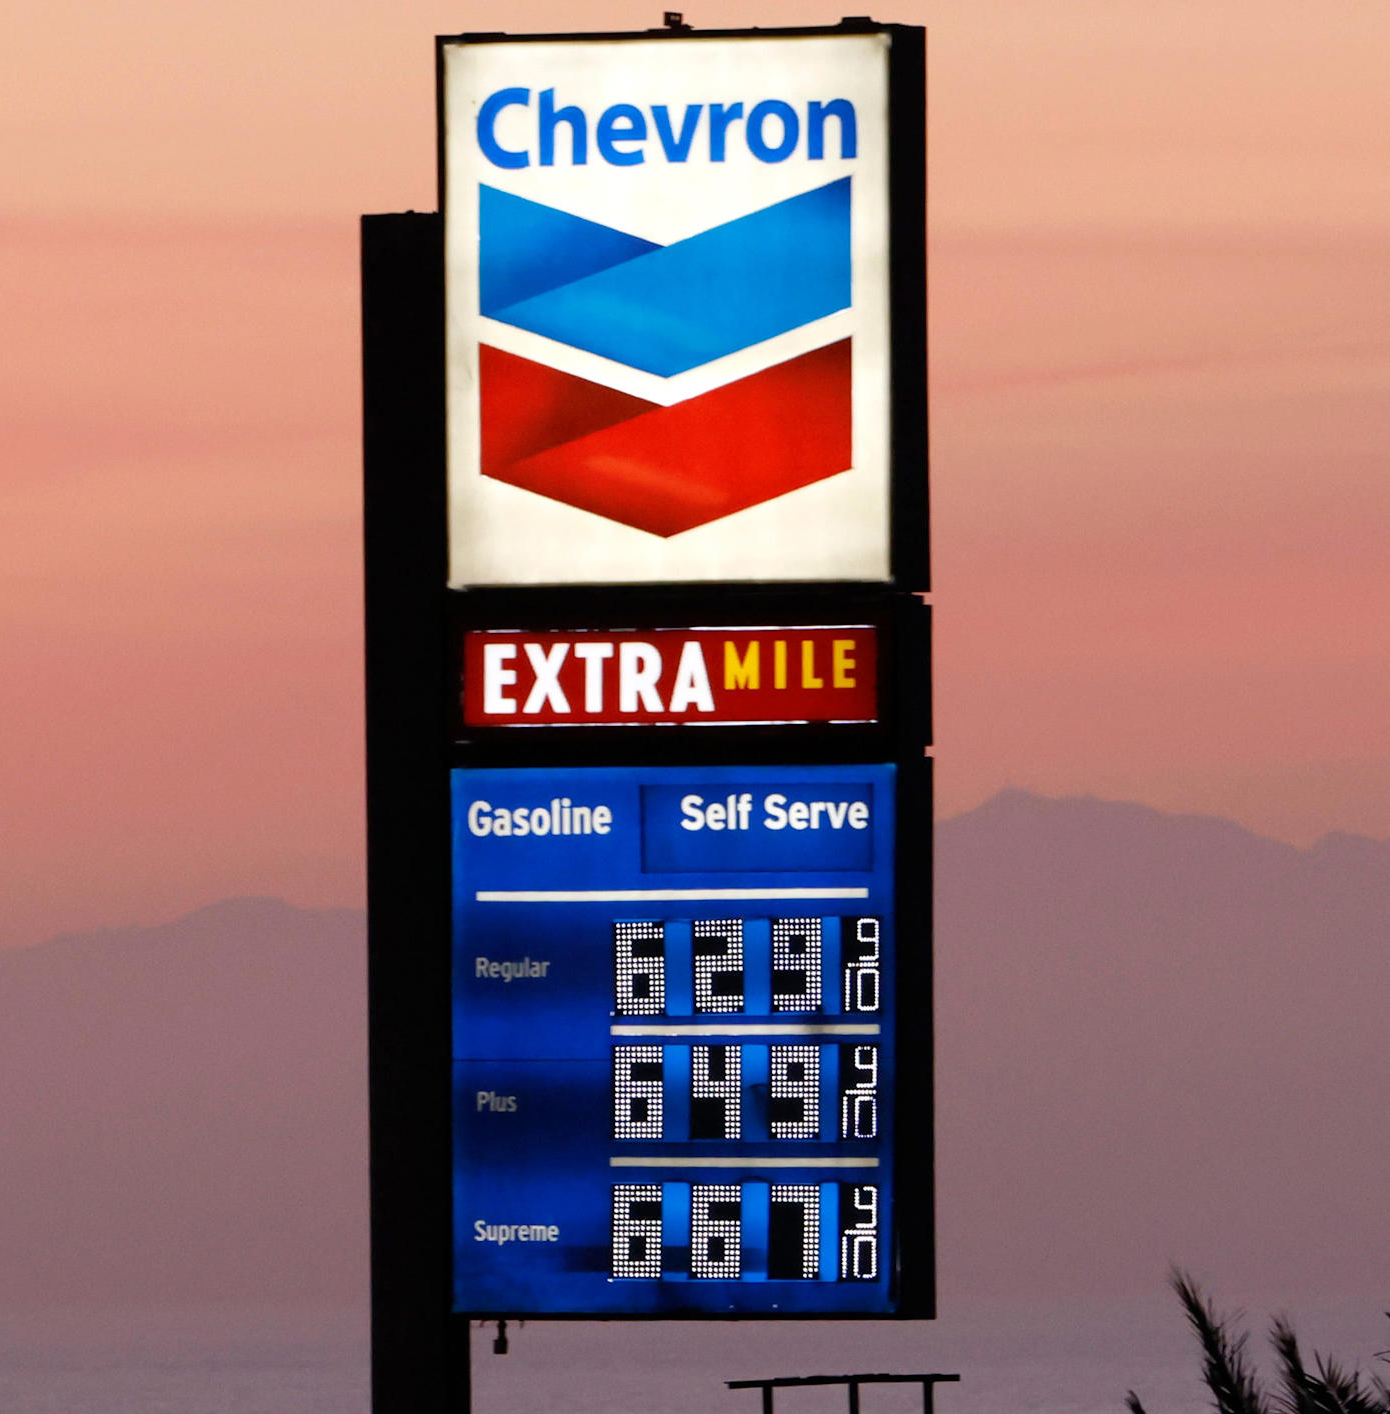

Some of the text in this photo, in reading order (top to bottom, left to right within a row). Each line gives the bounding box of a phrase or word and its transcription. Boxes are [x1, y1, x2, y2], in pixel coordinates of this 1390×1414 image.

[476, 87, 858, 169] Chevron
[483, 639, 856, 715] EXTRA MILE
[467, 798, 613, 836] Gasoline
[680, 793, 869, 831] Self Serve
[475, 956, 551, 983] Regular
[615, 918, 822, 1015] 629
[476, 1090, 517, 1112] Plus
[614, 1045, 820, 1140] 649
[473, 1219, 560, 1246] Supreme
[612, 1185, 820, 1279] 667
